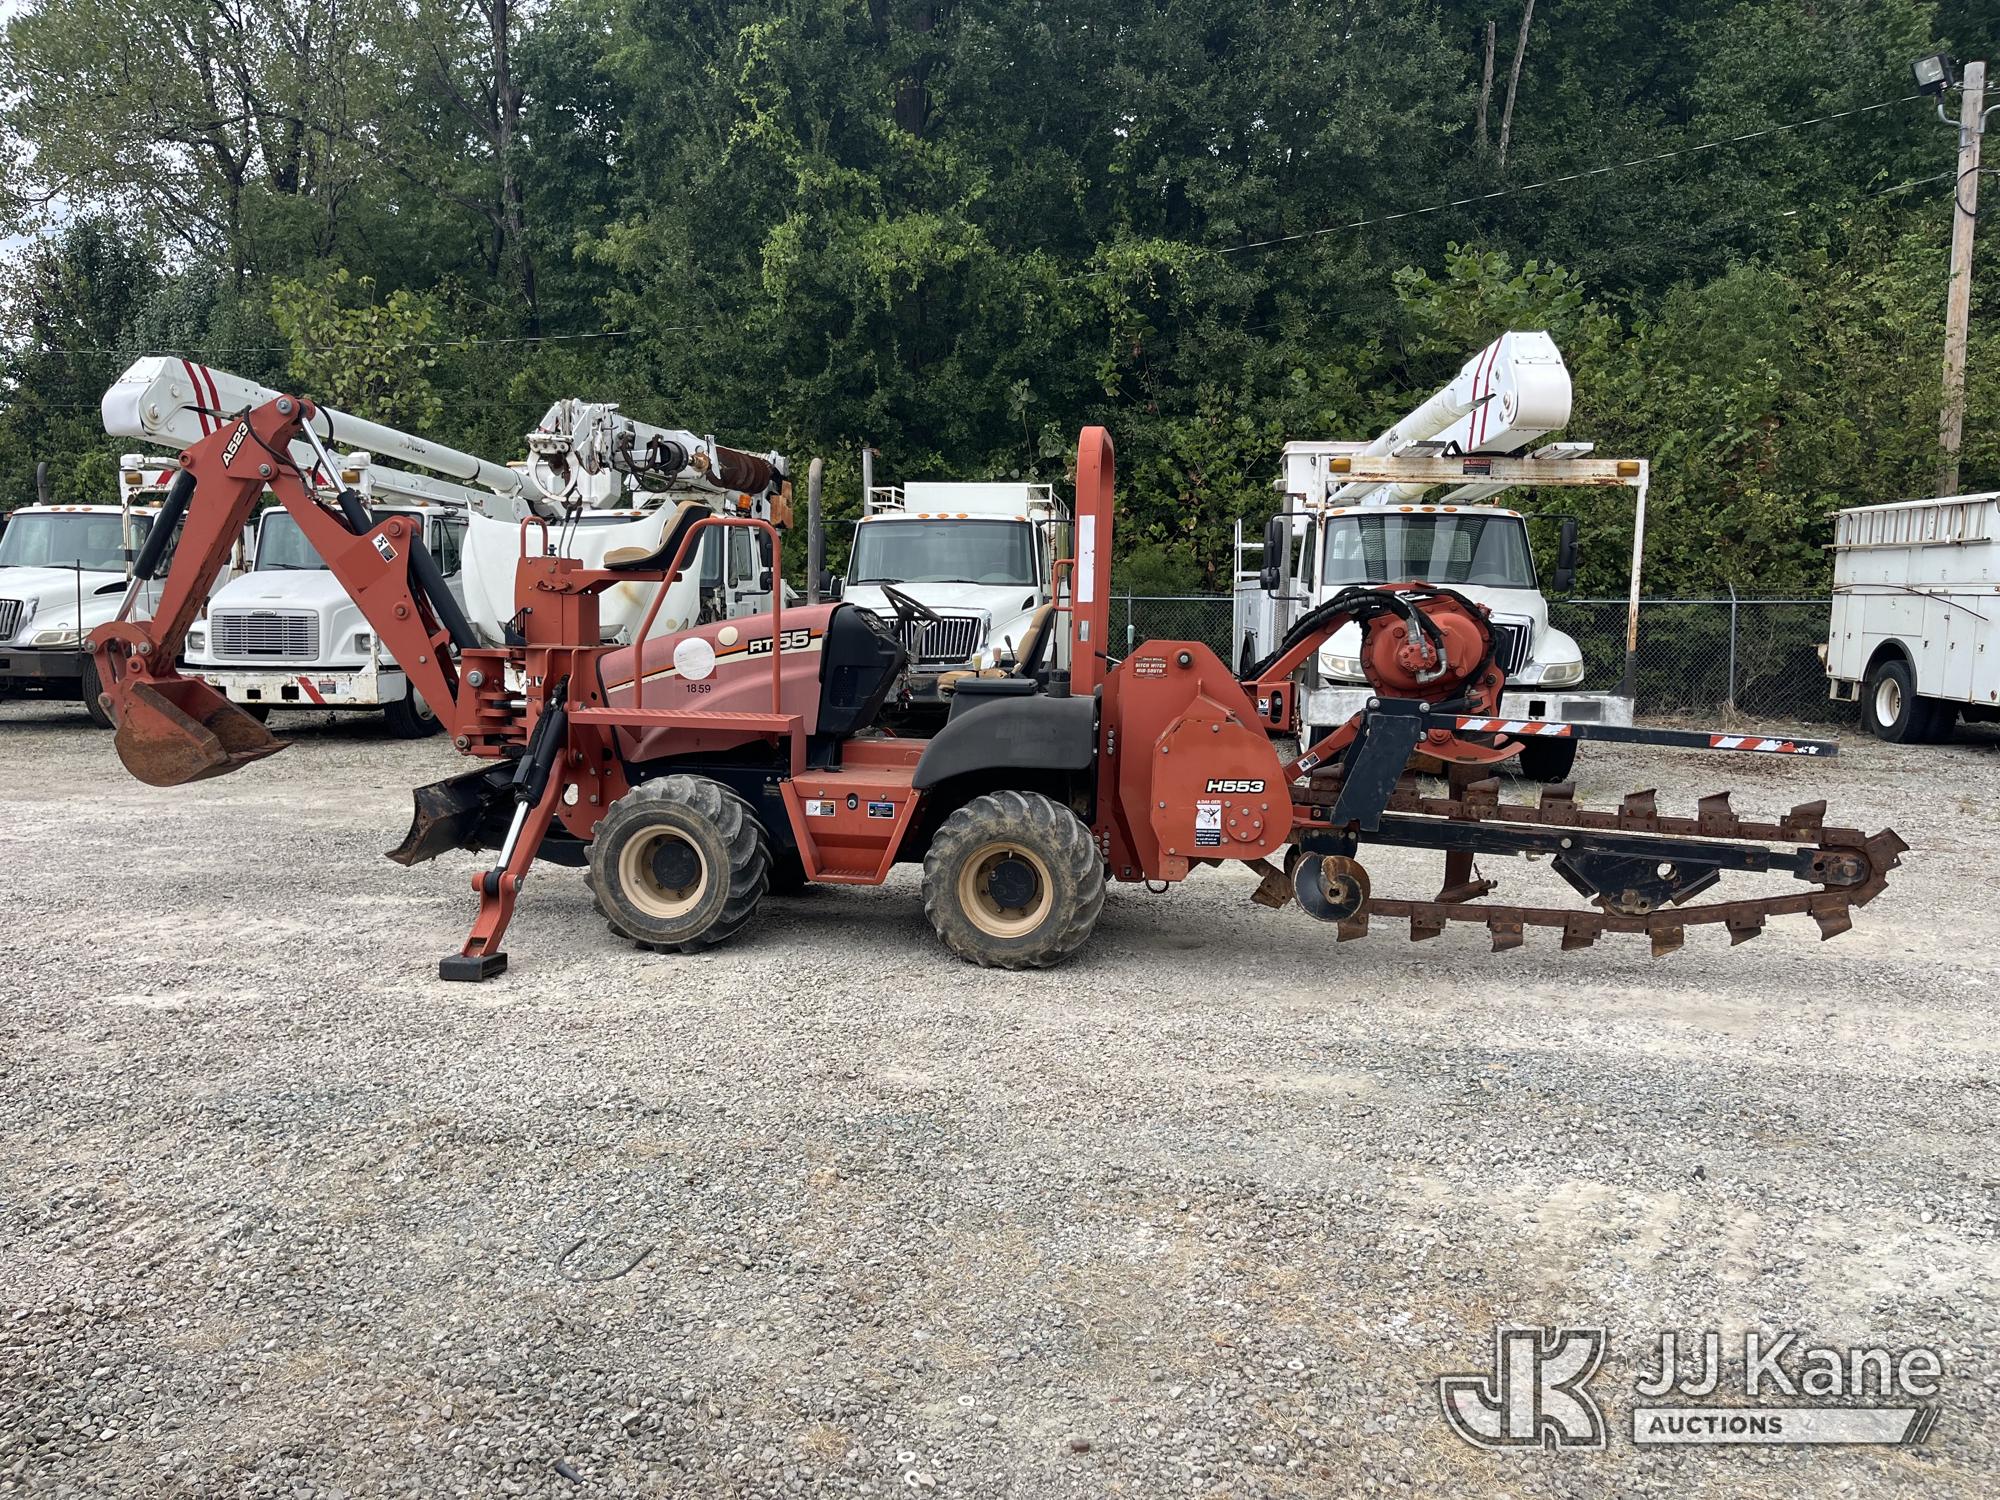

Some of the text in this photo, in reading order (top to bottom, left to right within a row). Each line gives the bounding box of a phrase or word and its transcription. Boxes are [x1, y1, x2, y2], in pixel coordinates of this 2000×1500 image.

[222, 421, 249, 468] A523
[749, 629, 810, 653] RT55
[686, 684, 711, 693] 1859
[1206, 780, 1265, 793] H553
